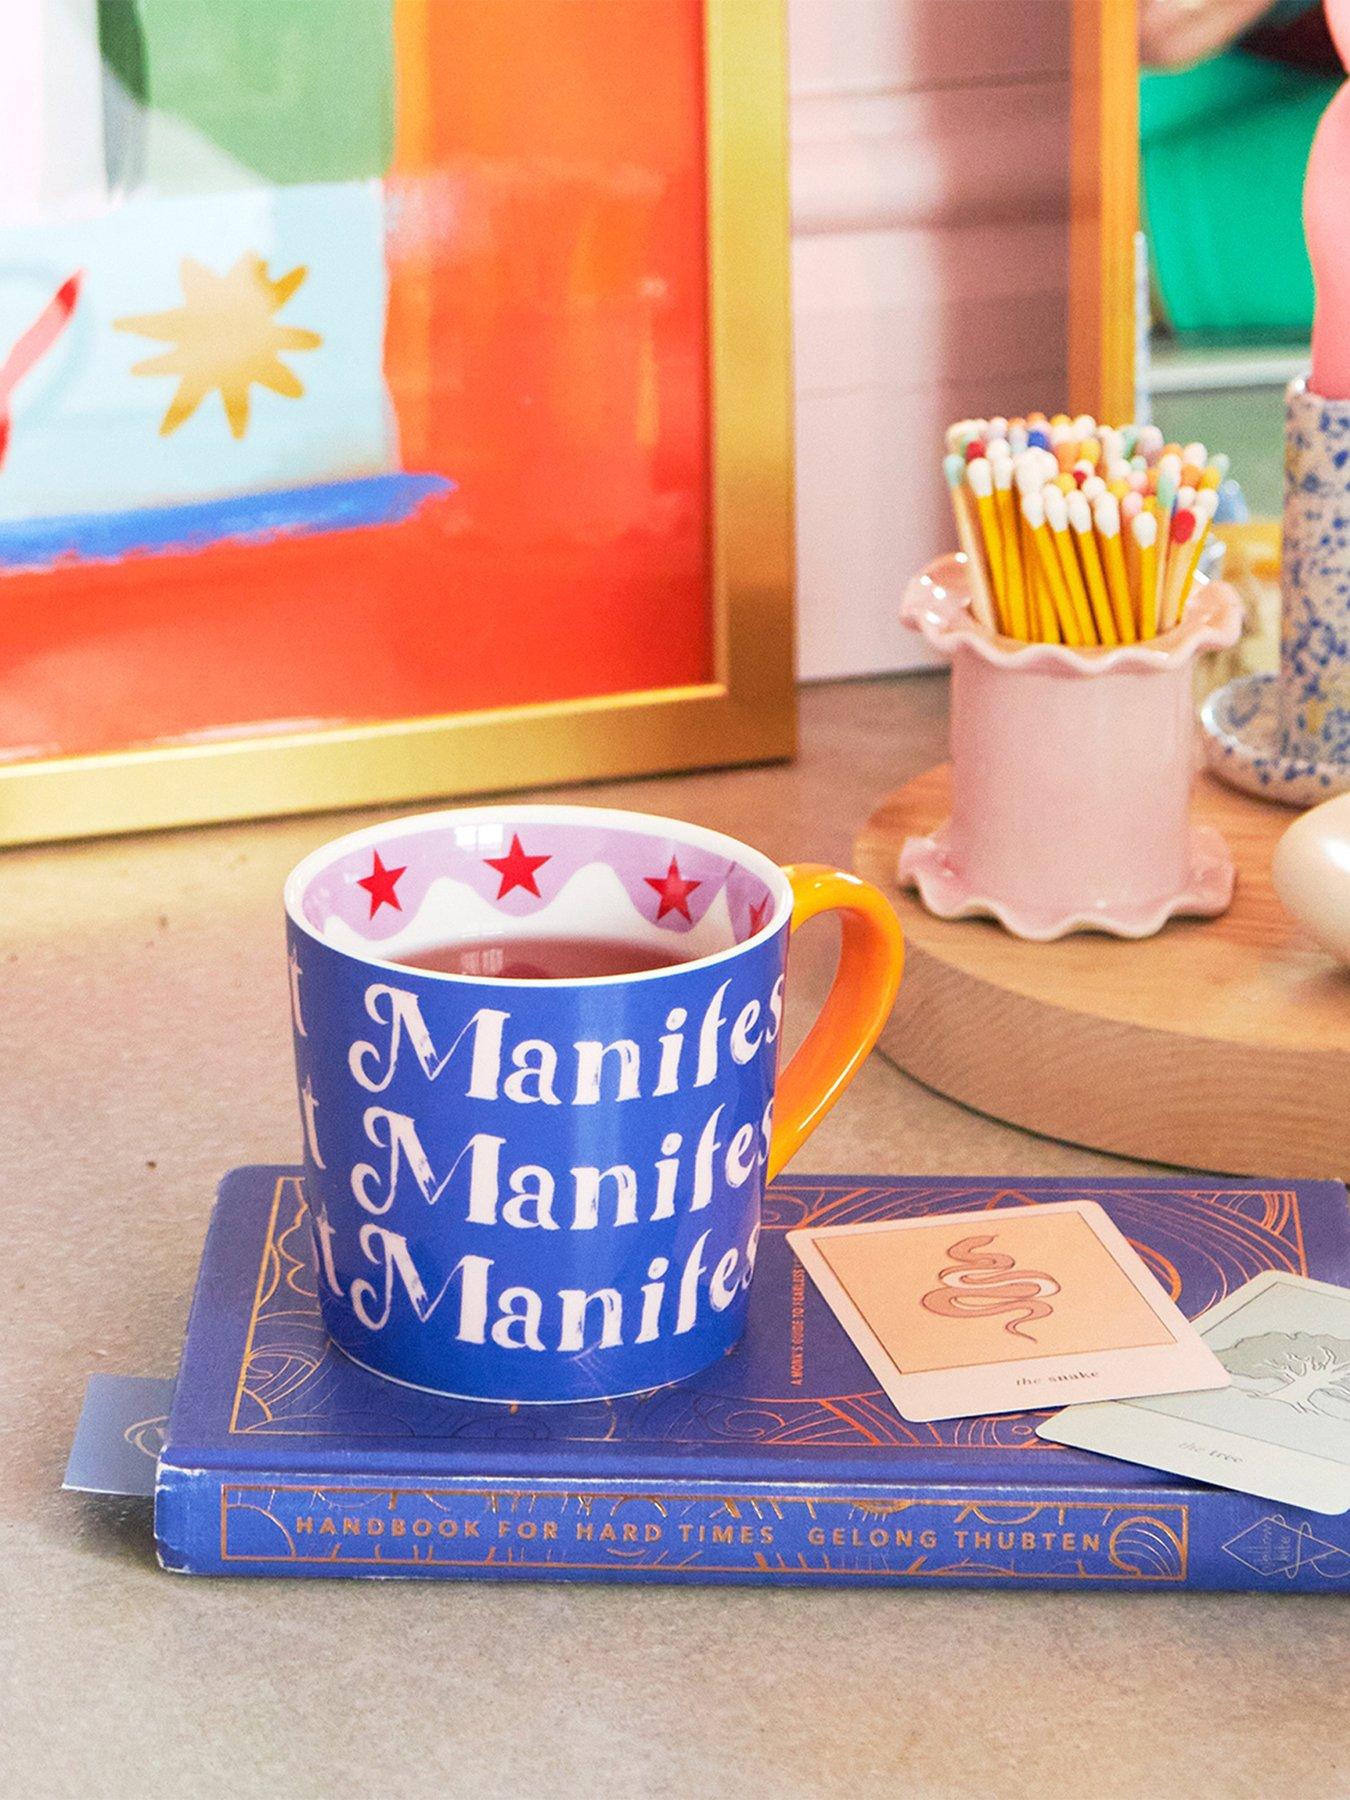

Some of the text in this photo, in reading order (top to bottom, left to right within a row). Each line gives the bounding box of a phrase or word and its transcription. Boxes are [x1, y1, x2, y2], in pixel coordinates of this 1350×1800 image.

[1048, 1369, 1100, 1382] snake
[296, 1515, 1101, 1552] HANDBOOK FOR HARD TIMES GELONG THUBTEN
